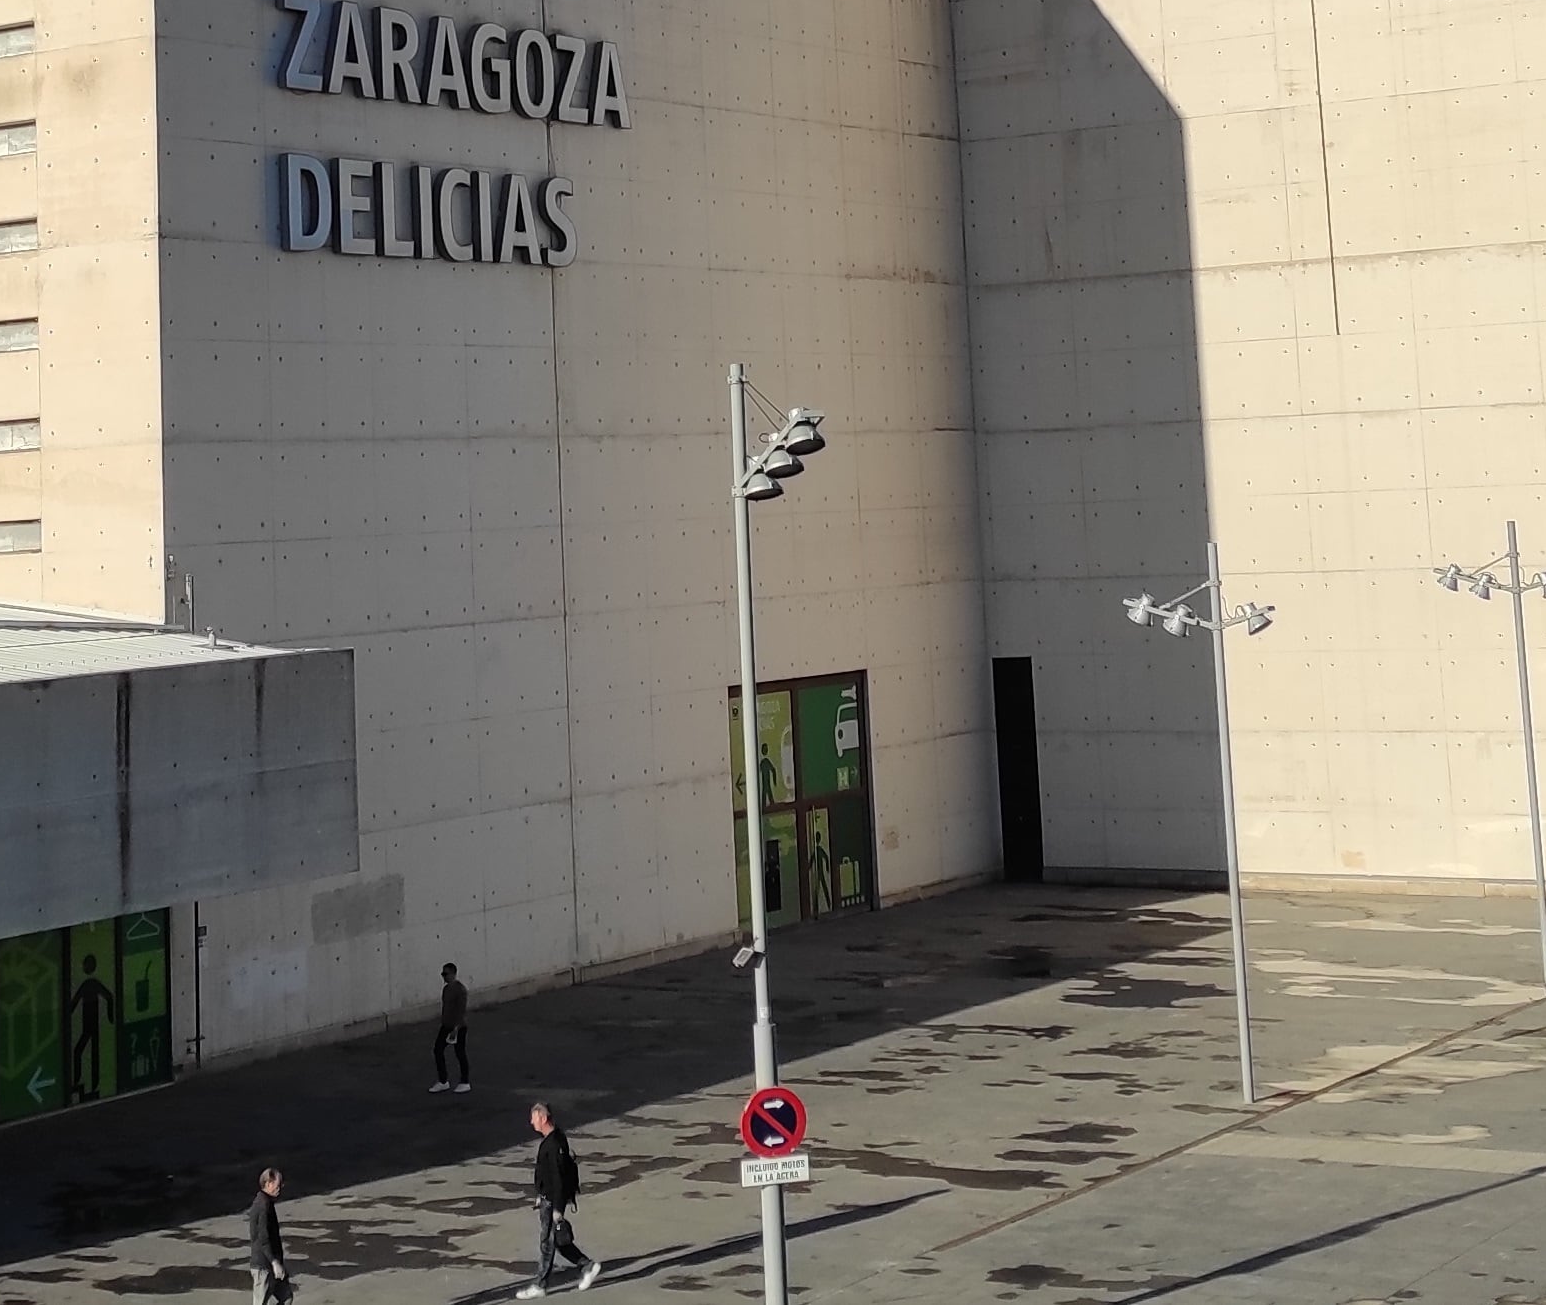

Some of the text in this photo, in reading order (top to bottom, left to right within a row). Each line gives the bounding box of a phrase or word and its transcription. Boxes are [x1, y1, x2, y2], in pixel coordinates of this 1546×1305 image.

[279, 153, 579, 268] DELICIAS
[746, 1159, 805, 1173] INCLUIDO MOTOS
[753, 1170, 799, 1183] EN LA ACERA
